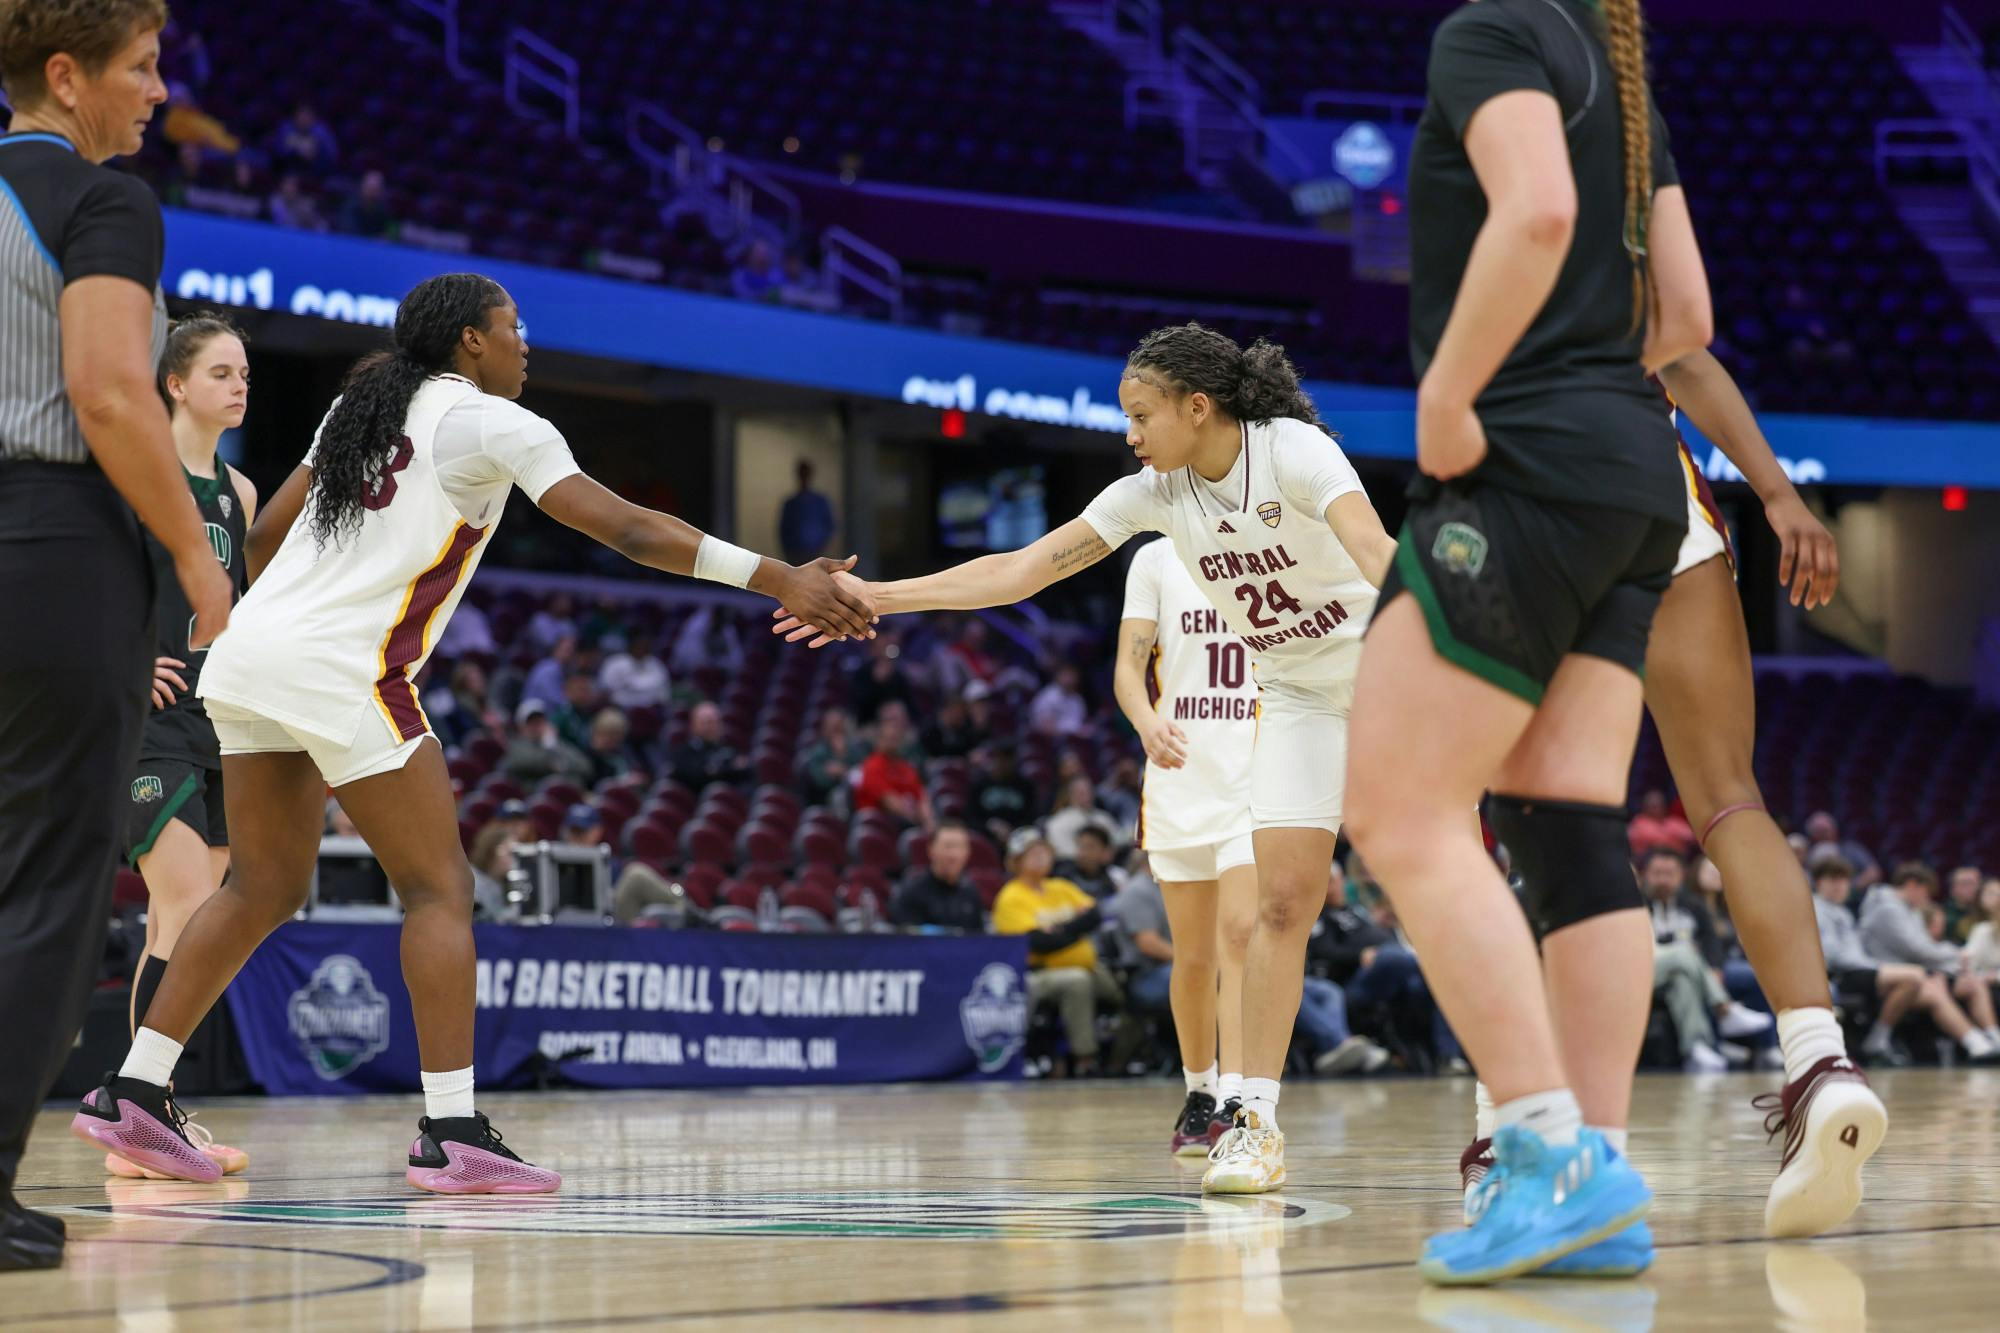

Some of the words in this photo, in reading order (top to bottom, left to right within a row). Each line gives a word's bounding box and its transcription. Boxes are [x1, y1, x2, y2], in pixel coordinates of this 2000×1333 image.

[1259, 507, 1281, 521] MAC
[1199, 544, 1298, 582] CENRAL
[1234, 579, 1303, 629] 24
[1205, 642, 1245, 689] 10
[1174, 697, 1257, 720] MICHIGA
[476, 959, 514, 1009] AC
[512, 959, 714, 1014] BASKETBALL
[720, 967, 925, 1017] TOURNAMENT
[622, 1031, 685, 1066] ARENA
[807, 1038, 838, 1070] OH
